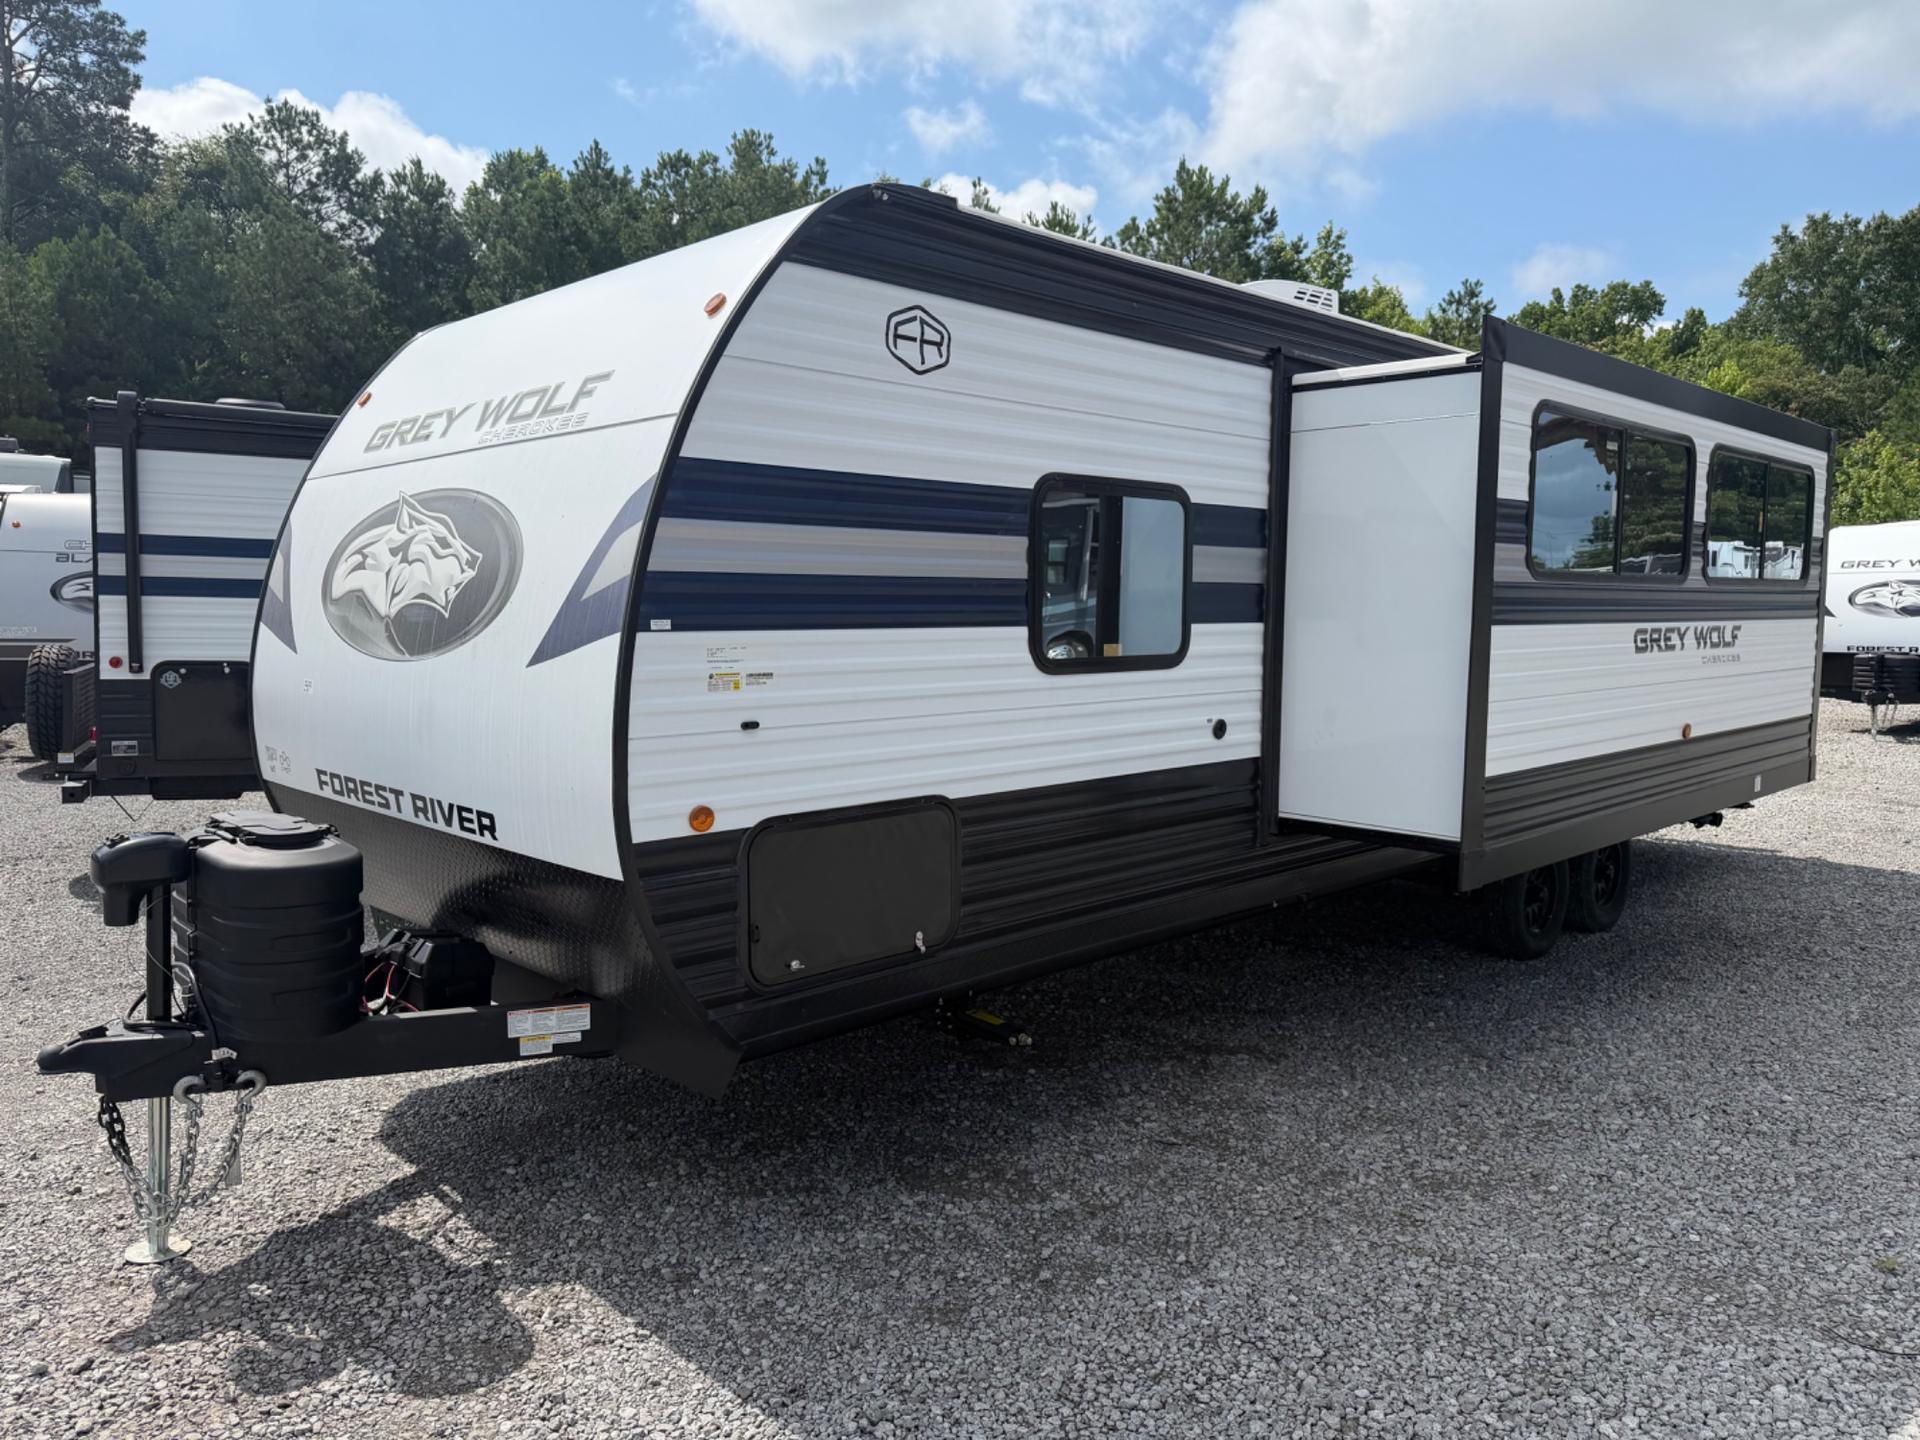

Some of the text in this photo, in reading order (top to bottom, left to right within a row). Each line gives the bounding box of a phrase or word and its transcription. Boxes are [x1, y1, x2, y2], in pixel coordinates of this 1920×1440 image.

[363, 369, 616, 454] GREY WOLF
[1840, 558, 1903, 569] GREY
[1633, 624, 1742, 655] GREY WOLF
[314, 767, 499, 842] FOREST RIVER
